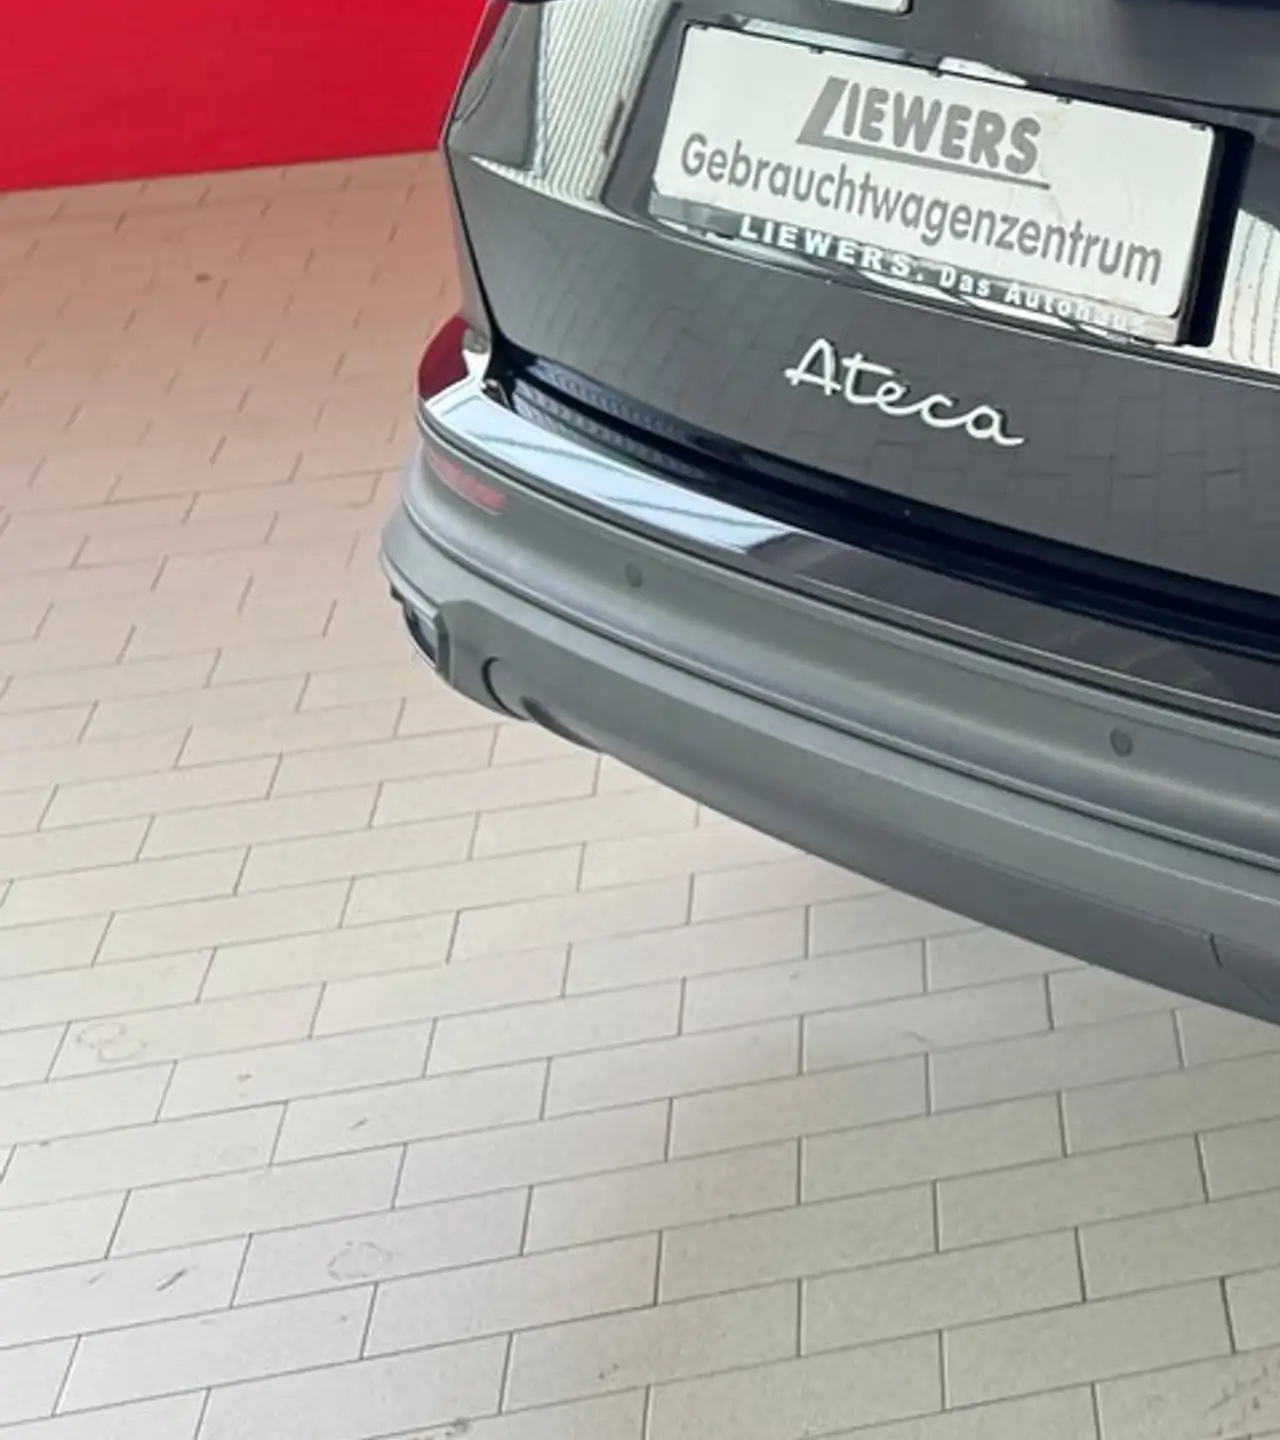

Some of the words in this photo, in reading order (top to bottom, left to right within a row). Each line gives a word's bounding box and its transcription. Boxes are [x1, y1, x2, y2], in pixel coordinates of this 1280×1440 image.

[796, 75, 1051, 191] LIEWERS
[680, 132, 1162, 286] Gebrauchtwagenzentrum
[739, 215, 924, 282] LIEWERS.
[938, 266, 991, 298] Das
[783, 337, 1027, 447] Ateca
